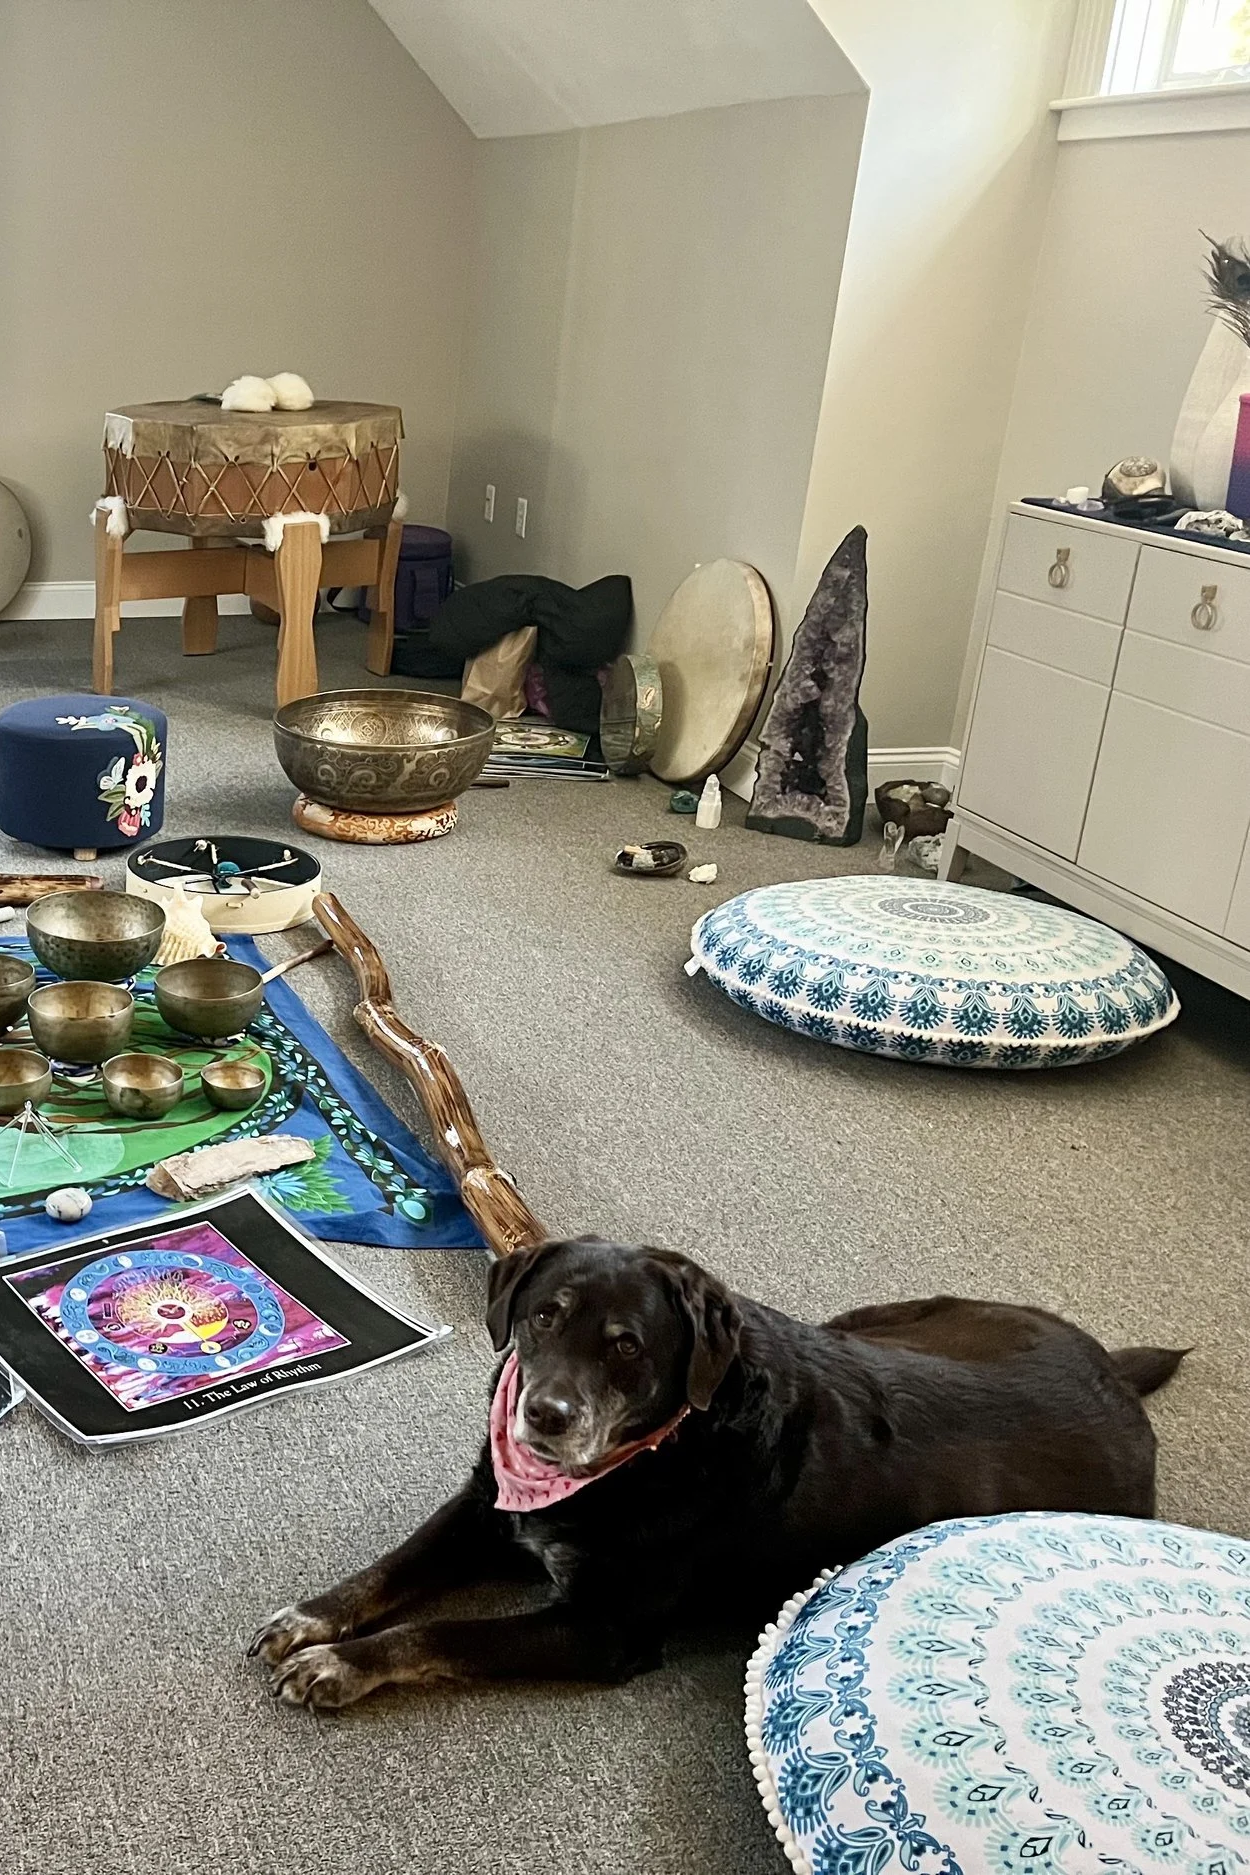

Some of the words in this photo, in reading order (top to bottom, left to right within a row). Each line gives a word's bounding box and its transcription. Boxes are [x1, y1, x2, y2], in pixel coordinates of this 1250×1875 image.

[183, 1399, 205, 1410] 11.
[202, 1390, 232, 1403] The
[230, 1381, 258, 1394] Law
[260, 1373, 274, 1385] of
[271, 1362, 322, 1380] Rhythm
